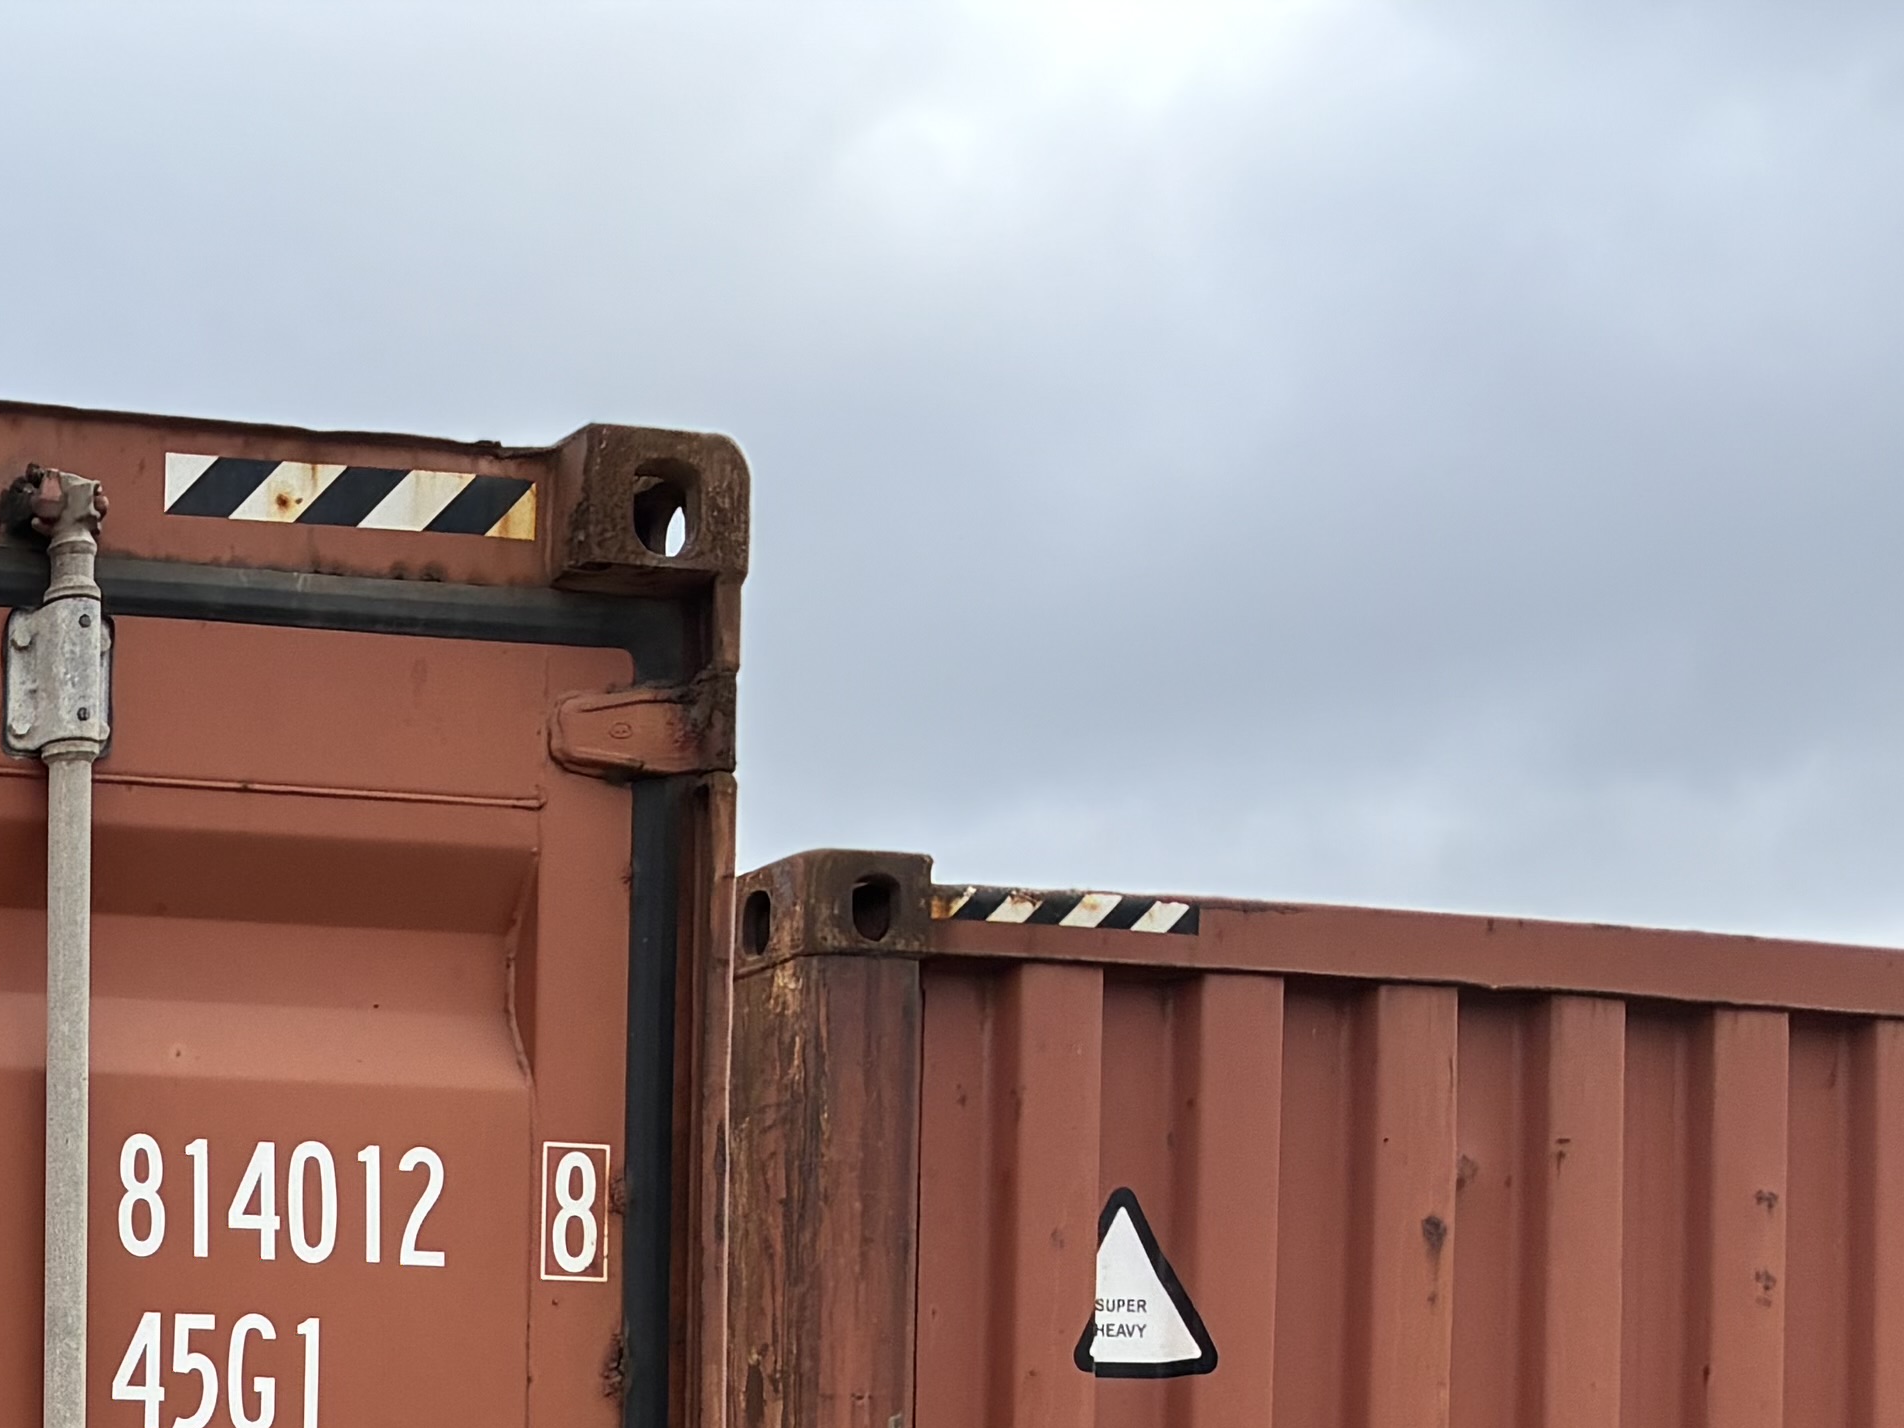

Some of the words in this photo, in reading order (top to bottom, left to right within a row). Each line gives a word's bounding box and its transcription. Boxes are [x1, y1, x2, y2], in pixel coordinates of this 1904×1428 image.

[118, 1134, 445, 1267] 814012
[553, 1151, 597, 1273] 8
[1094, 1298, 1148, 1313] SUPER
[1094, 1323, 1148, 1338] HEAVY
